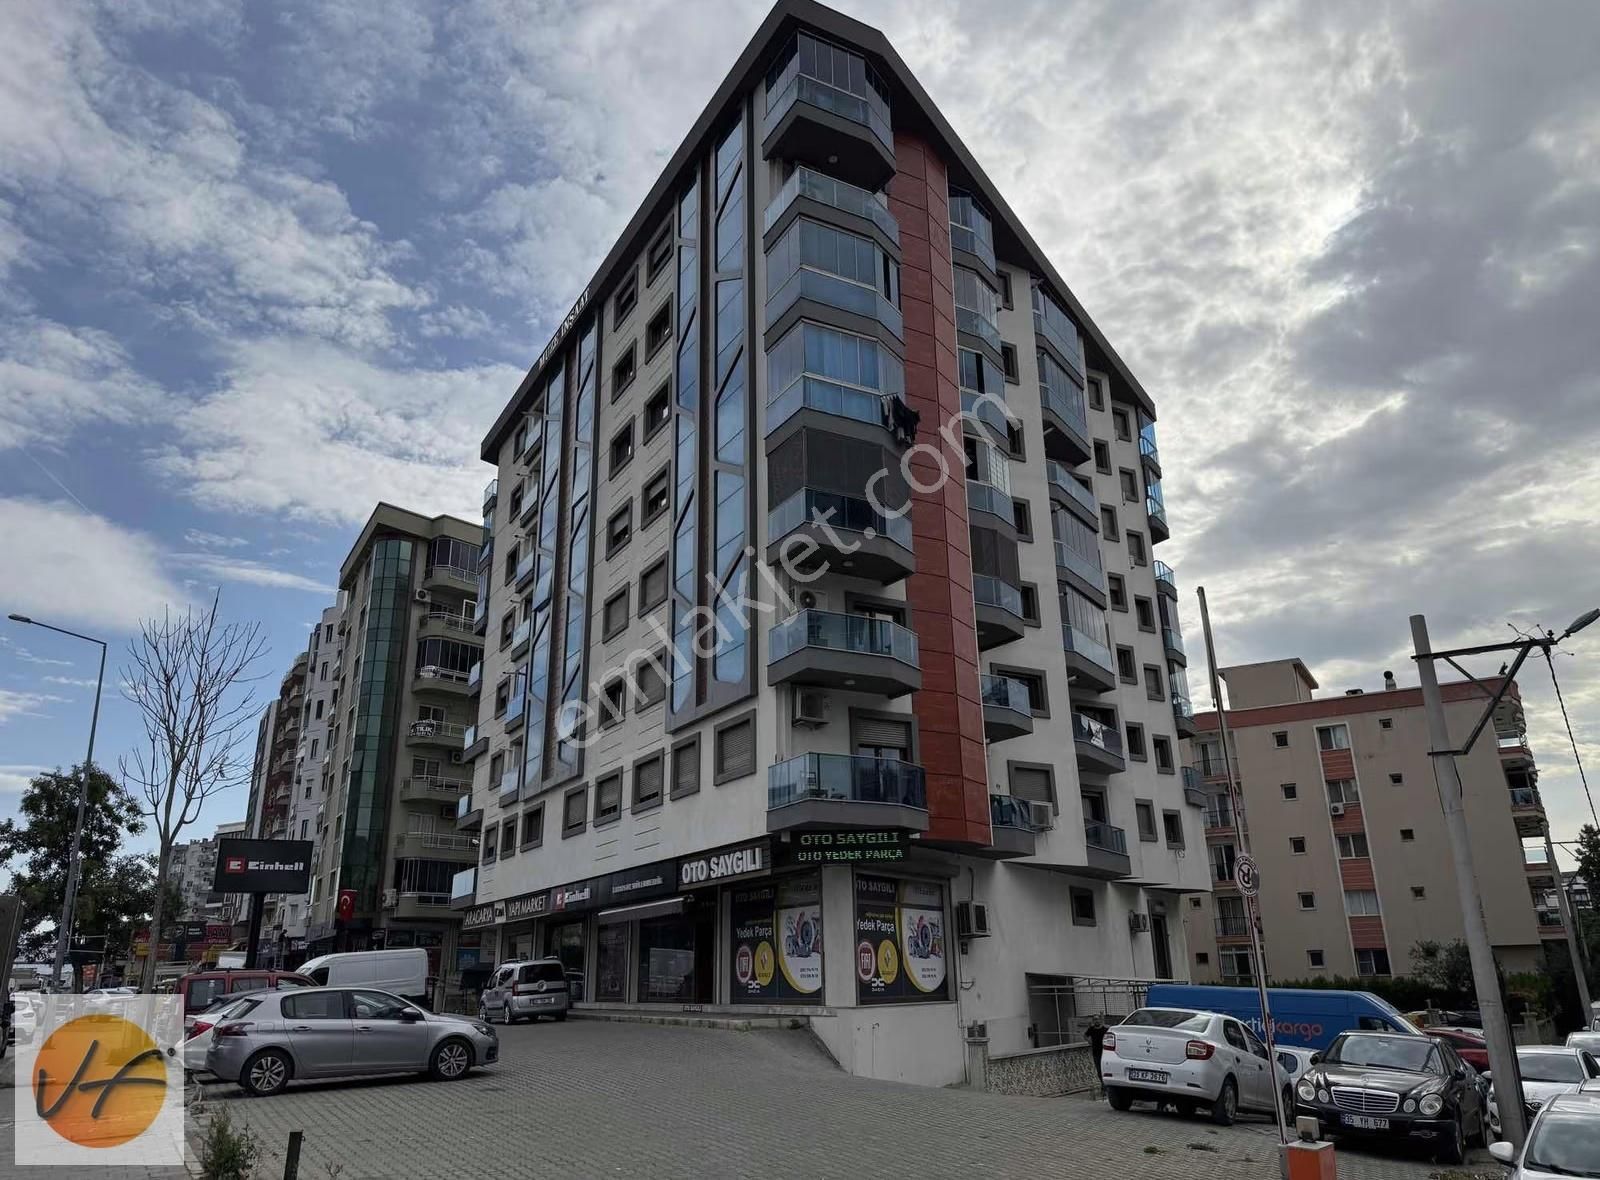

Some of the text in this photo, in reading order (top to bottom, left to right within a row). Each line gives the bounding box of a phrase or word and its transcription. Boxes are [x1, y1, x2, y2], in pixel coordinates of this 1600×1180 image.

[800, 832, 899, 845] OTO SAYGILI
[798, 849, 903, 861] OTO YEDEK PARÇA
[248, 860, 304, 871] Einhell
[682, 847, 763, 884] OTO SAYGILI
[736, 926, 773, 938] Yedek Parça
[876, 919, 895, 934] Parça
